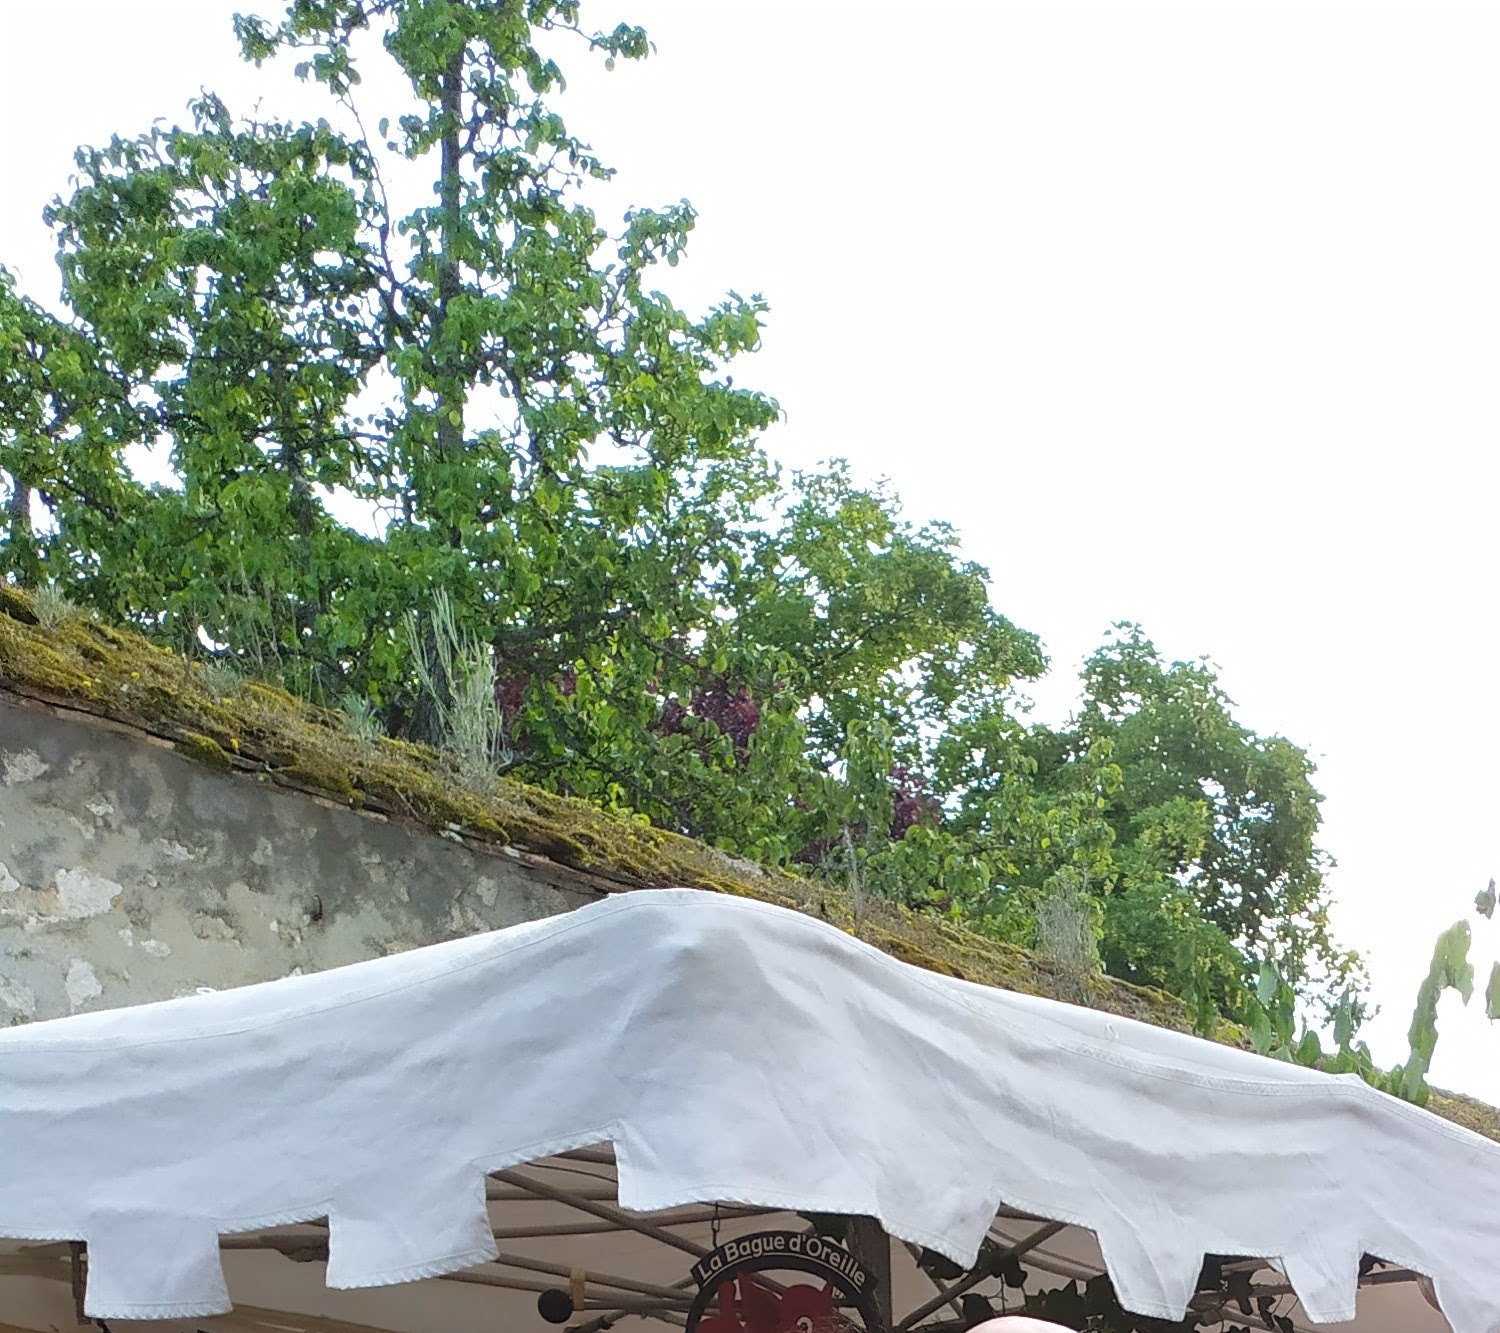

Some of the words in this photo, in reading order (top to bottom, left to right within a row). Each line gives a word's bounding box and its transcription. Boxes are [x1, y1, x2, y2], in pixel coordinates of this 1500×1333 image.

[697, 1257, 723, 1281] La
[724, 1235, 785, 1261] Bague
[789, 1233, 867, 1287] d'Oreille
